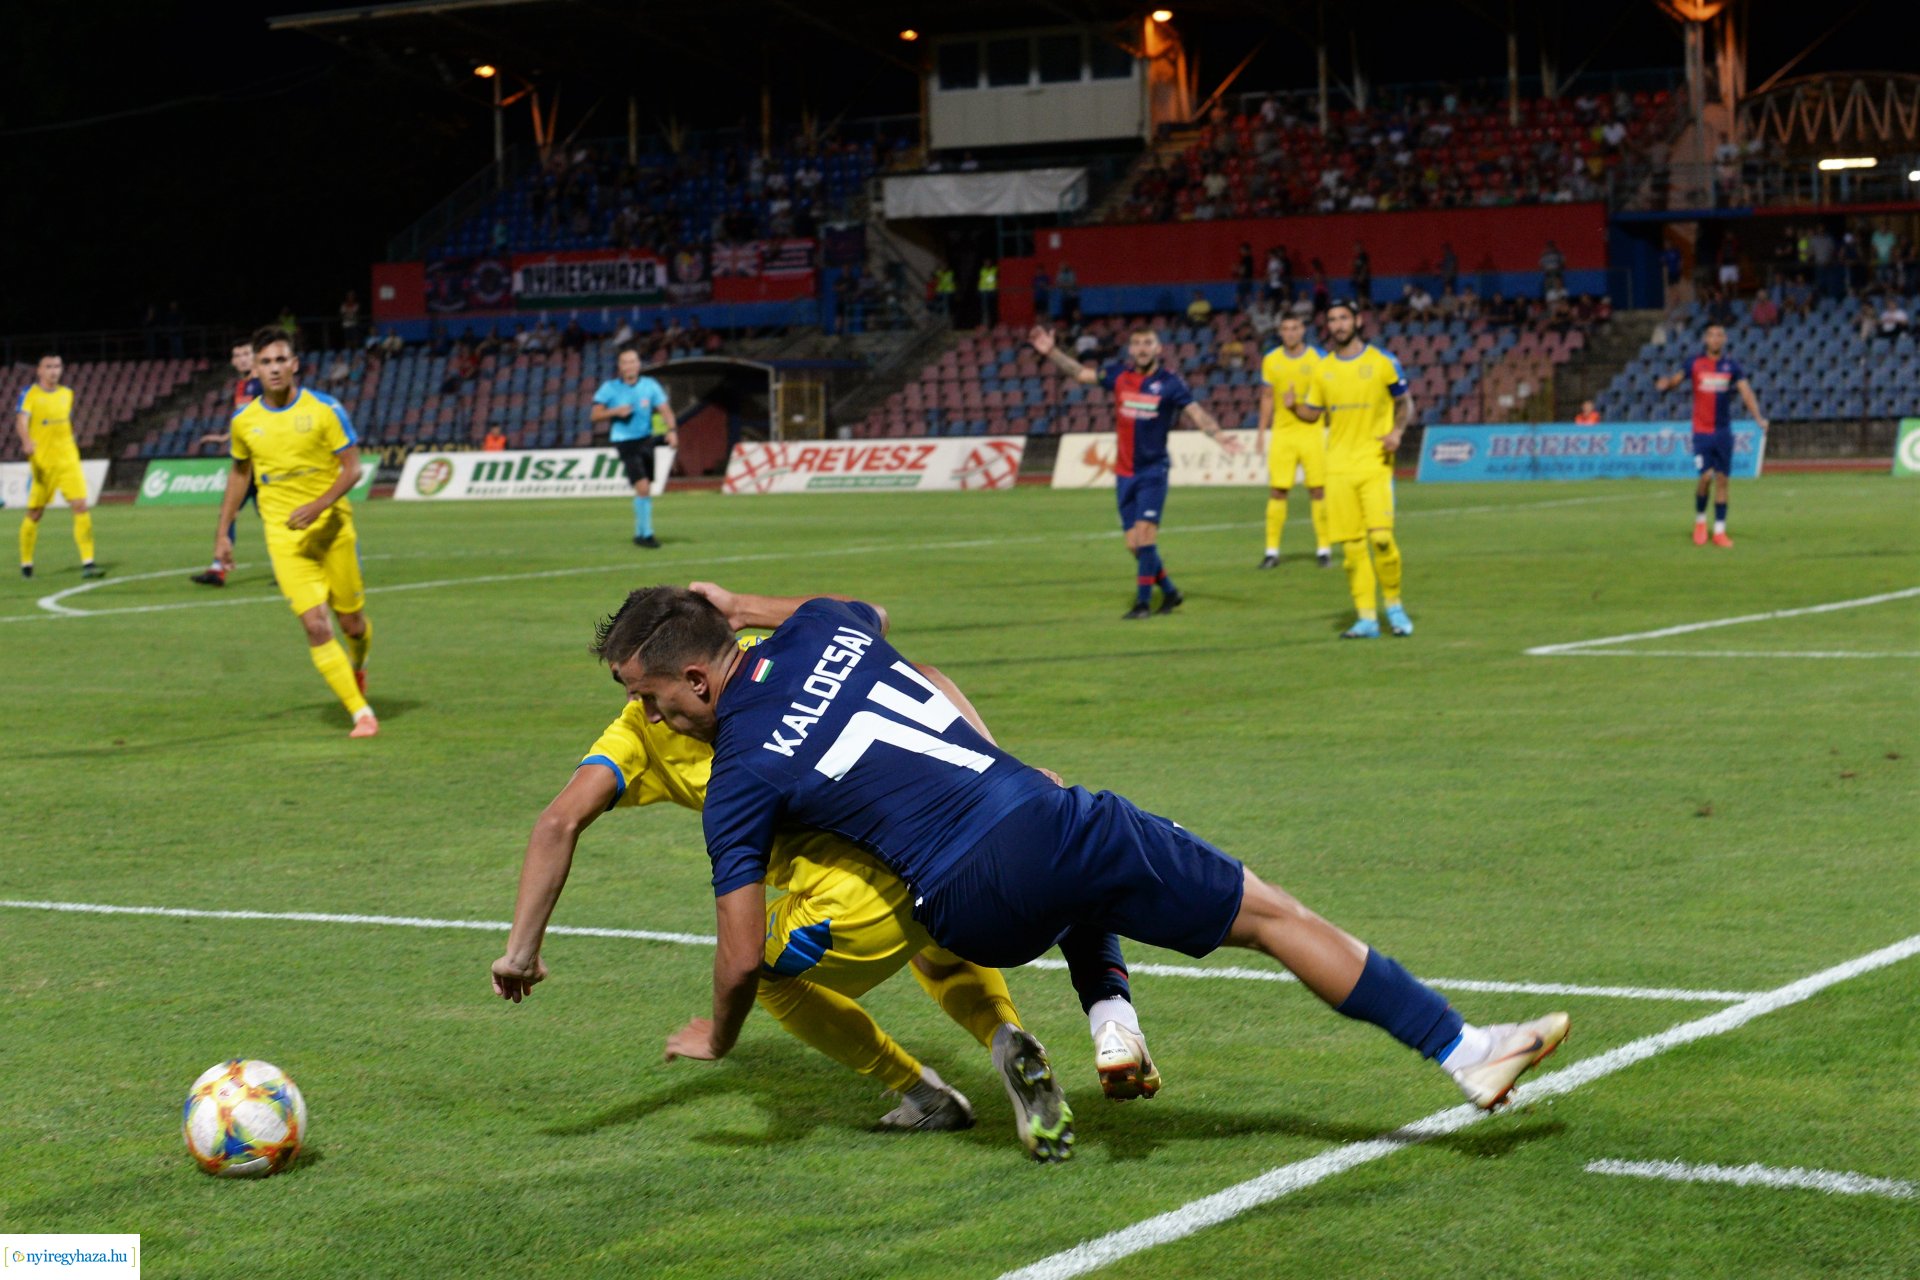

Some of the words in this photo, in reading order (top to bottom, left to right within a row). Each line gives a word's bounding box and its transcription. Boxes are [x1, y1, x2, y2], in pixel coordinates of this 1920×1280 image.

[470, 454, 628, 481] mlsz.h
[793, 445, 937, 472] REVESZ
[168, 467, 227, 493] merk
[762, 626, 873, 757] KALOCSAI
[814, 660, 996, 781] 74
